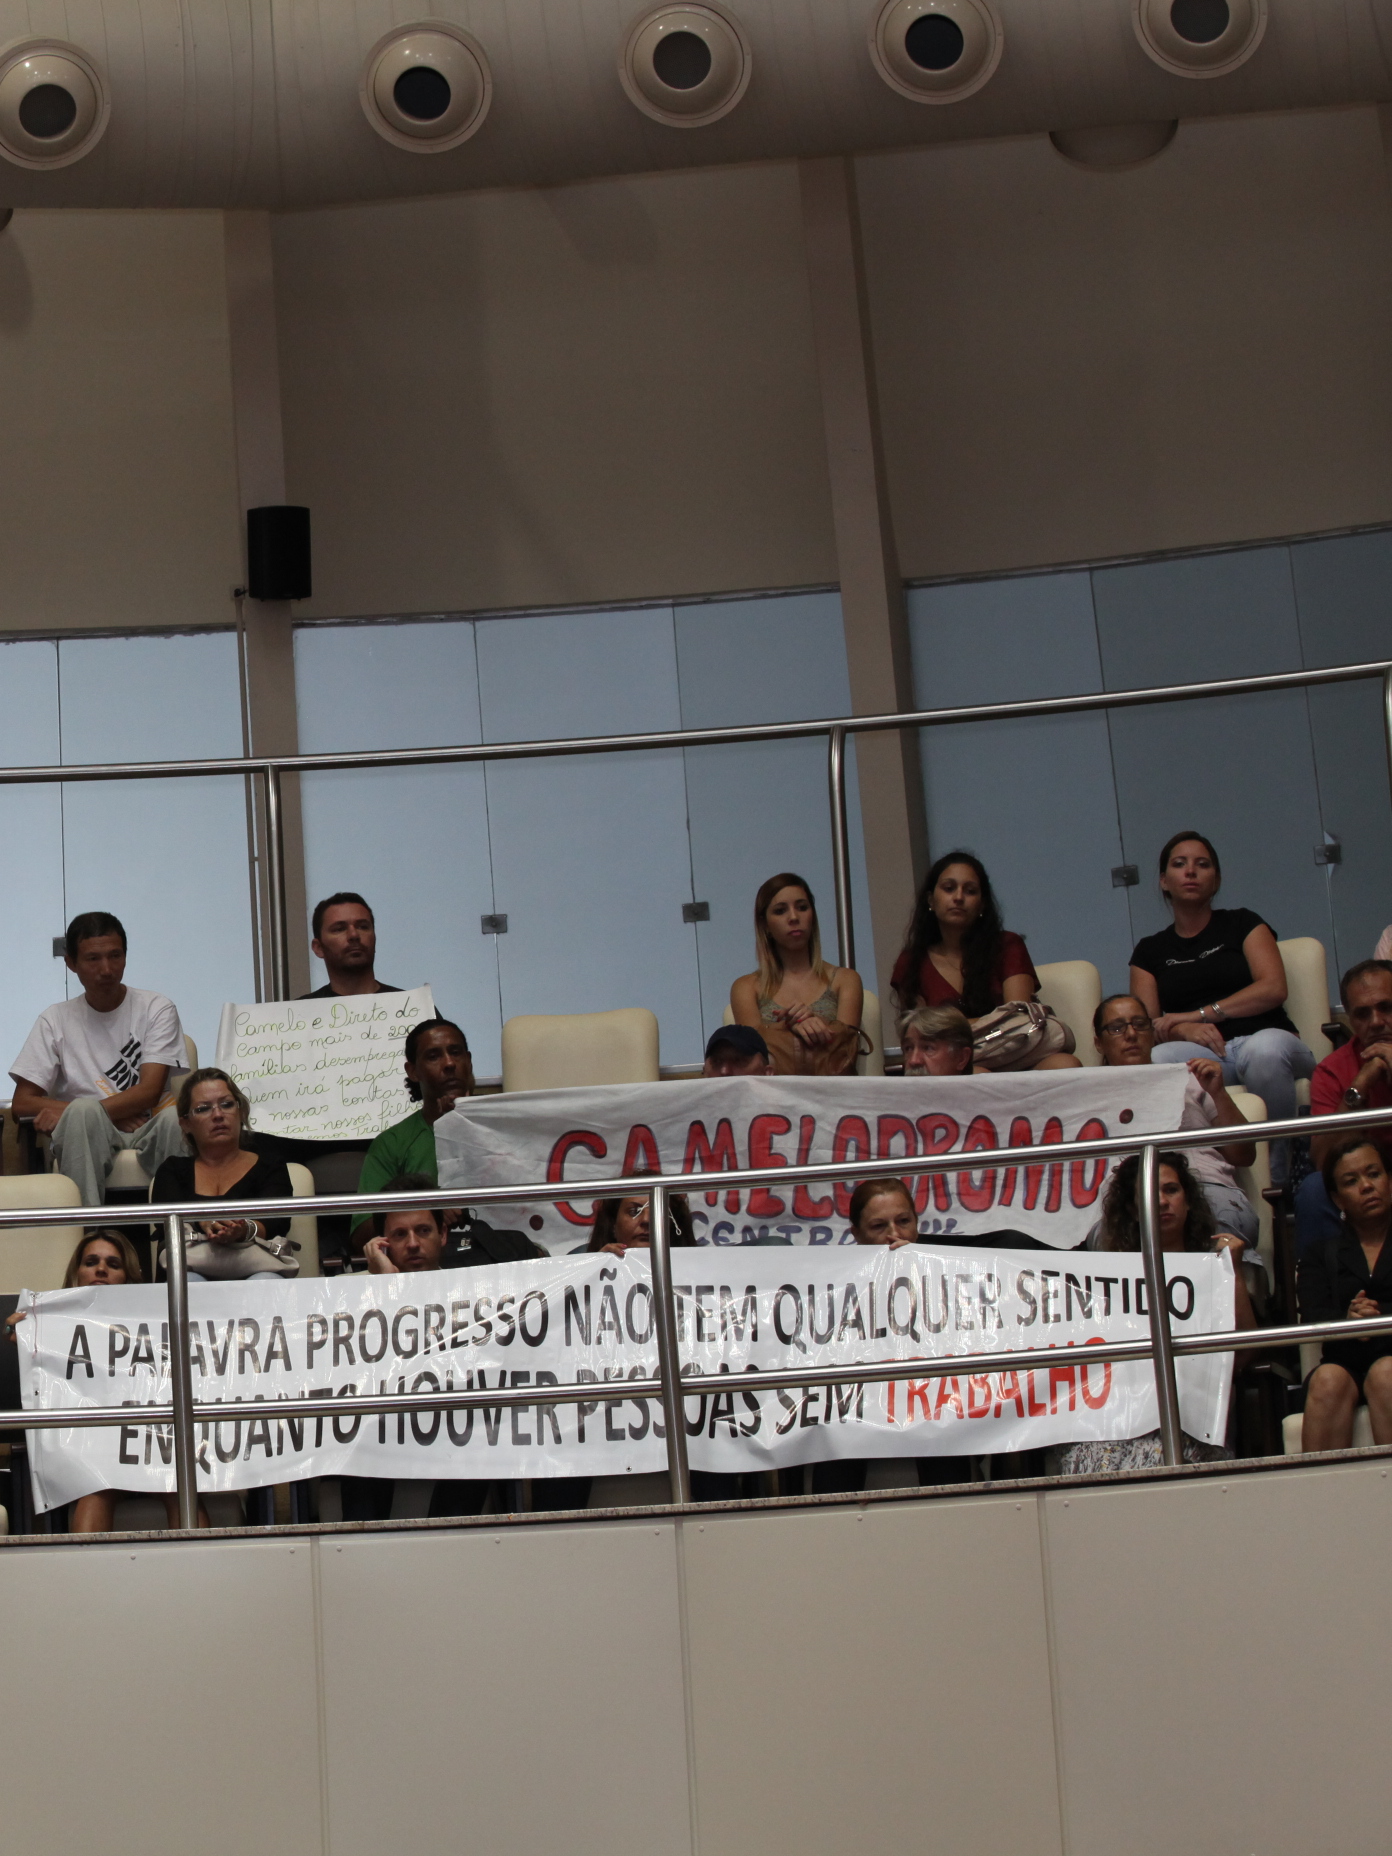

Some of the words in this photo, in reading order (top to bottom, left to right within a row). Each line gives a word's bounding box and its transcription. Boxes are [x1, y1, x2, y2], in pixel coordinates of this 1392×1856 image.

[311, 1017, 324, 1030] e
[395, 995, 421, 1019] do
[308, 1032, 353, 1050] mais
[360, 1024, 382, 1041] de
[313, 1046, 407, 1076] desemprega
[268, 1104, 329, 1122] nossas
[342, 1084, 405, 1107] contas
[320, 1112, 372, 1130] nossos
[377, 1099, 424, 1132] filho
[545, 1112, 1108, 1227] CAMELODROMO
[65, 1324, 95, 1380] A
[108, 1315, 293, 1379] PALAVRA
[306, 1289, 550, 1371] PROGRESSO
[563, 1267, 655, 1348] NÃO
[669, 1284, 759, 1343] TEM
[772, 1271, 1004, 1356] QUALQUER
[1015, 1268, 1196, 1328] SENTIDO
[119, 1386, 363, 1475] ENQUANTO
[378, 1369, 563, 1447] HOUVER
[577, 1362, 762, 1444] PESSOAS
[775, 1362, 865, 1436] SEM
[880, 1336, 1112, 1424] TRABALHO
